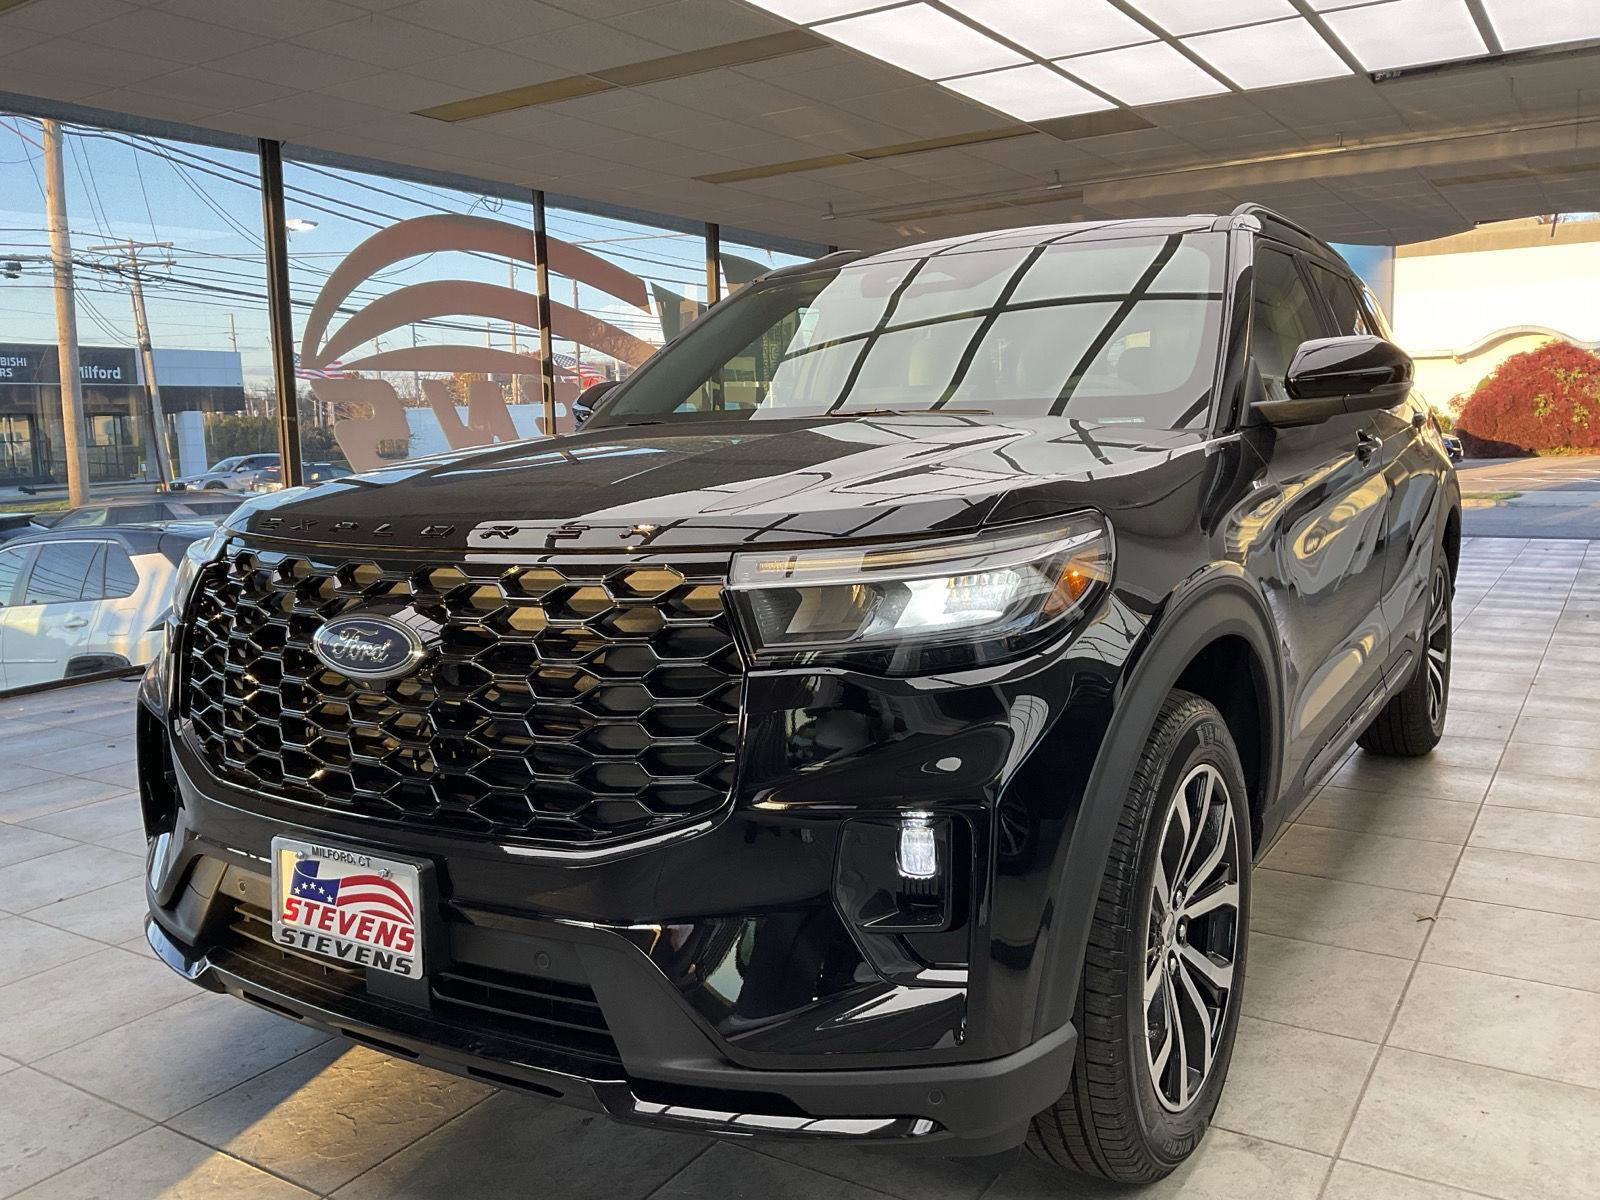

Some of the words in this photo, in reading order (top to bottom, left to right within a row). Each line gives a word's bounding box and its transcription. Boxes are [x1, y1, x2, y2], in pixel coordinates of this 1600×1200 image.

[332, 627, 391, 663] Ford
[358, 855, 372, 868] CT
[282, 897, 415, 953] STEVENS
[279, 927, 414, 976] STEVENS
